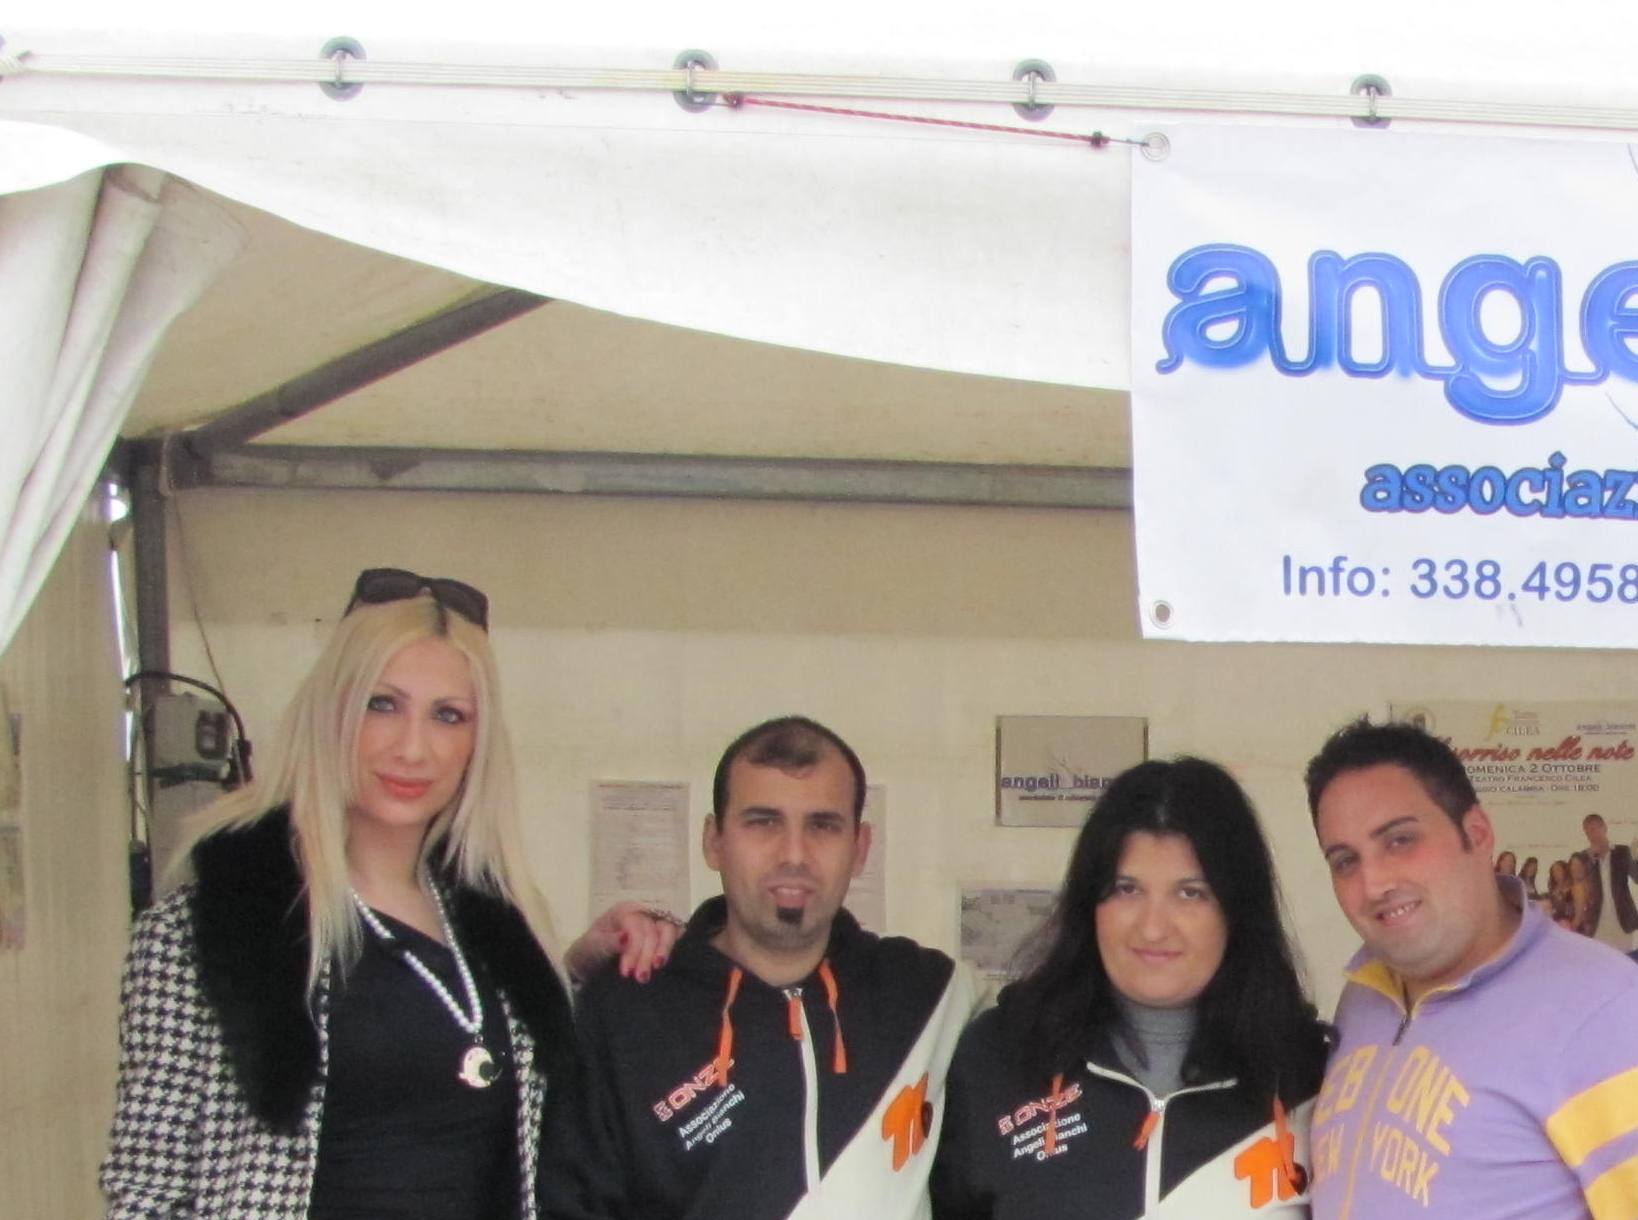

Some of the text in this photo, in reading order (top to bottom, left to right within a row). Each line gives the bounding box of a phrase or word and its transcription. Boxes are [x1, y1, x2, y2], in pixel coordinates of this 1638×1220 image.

[1282, 555, 1391, 599] Info:
[1466, 765, 1525, 774] OMENICA
[1530, 763, 1538, 773] 2
[1072, 774, 1111, 788] bian
[1013, 1113, 1081, 1146] Associione
